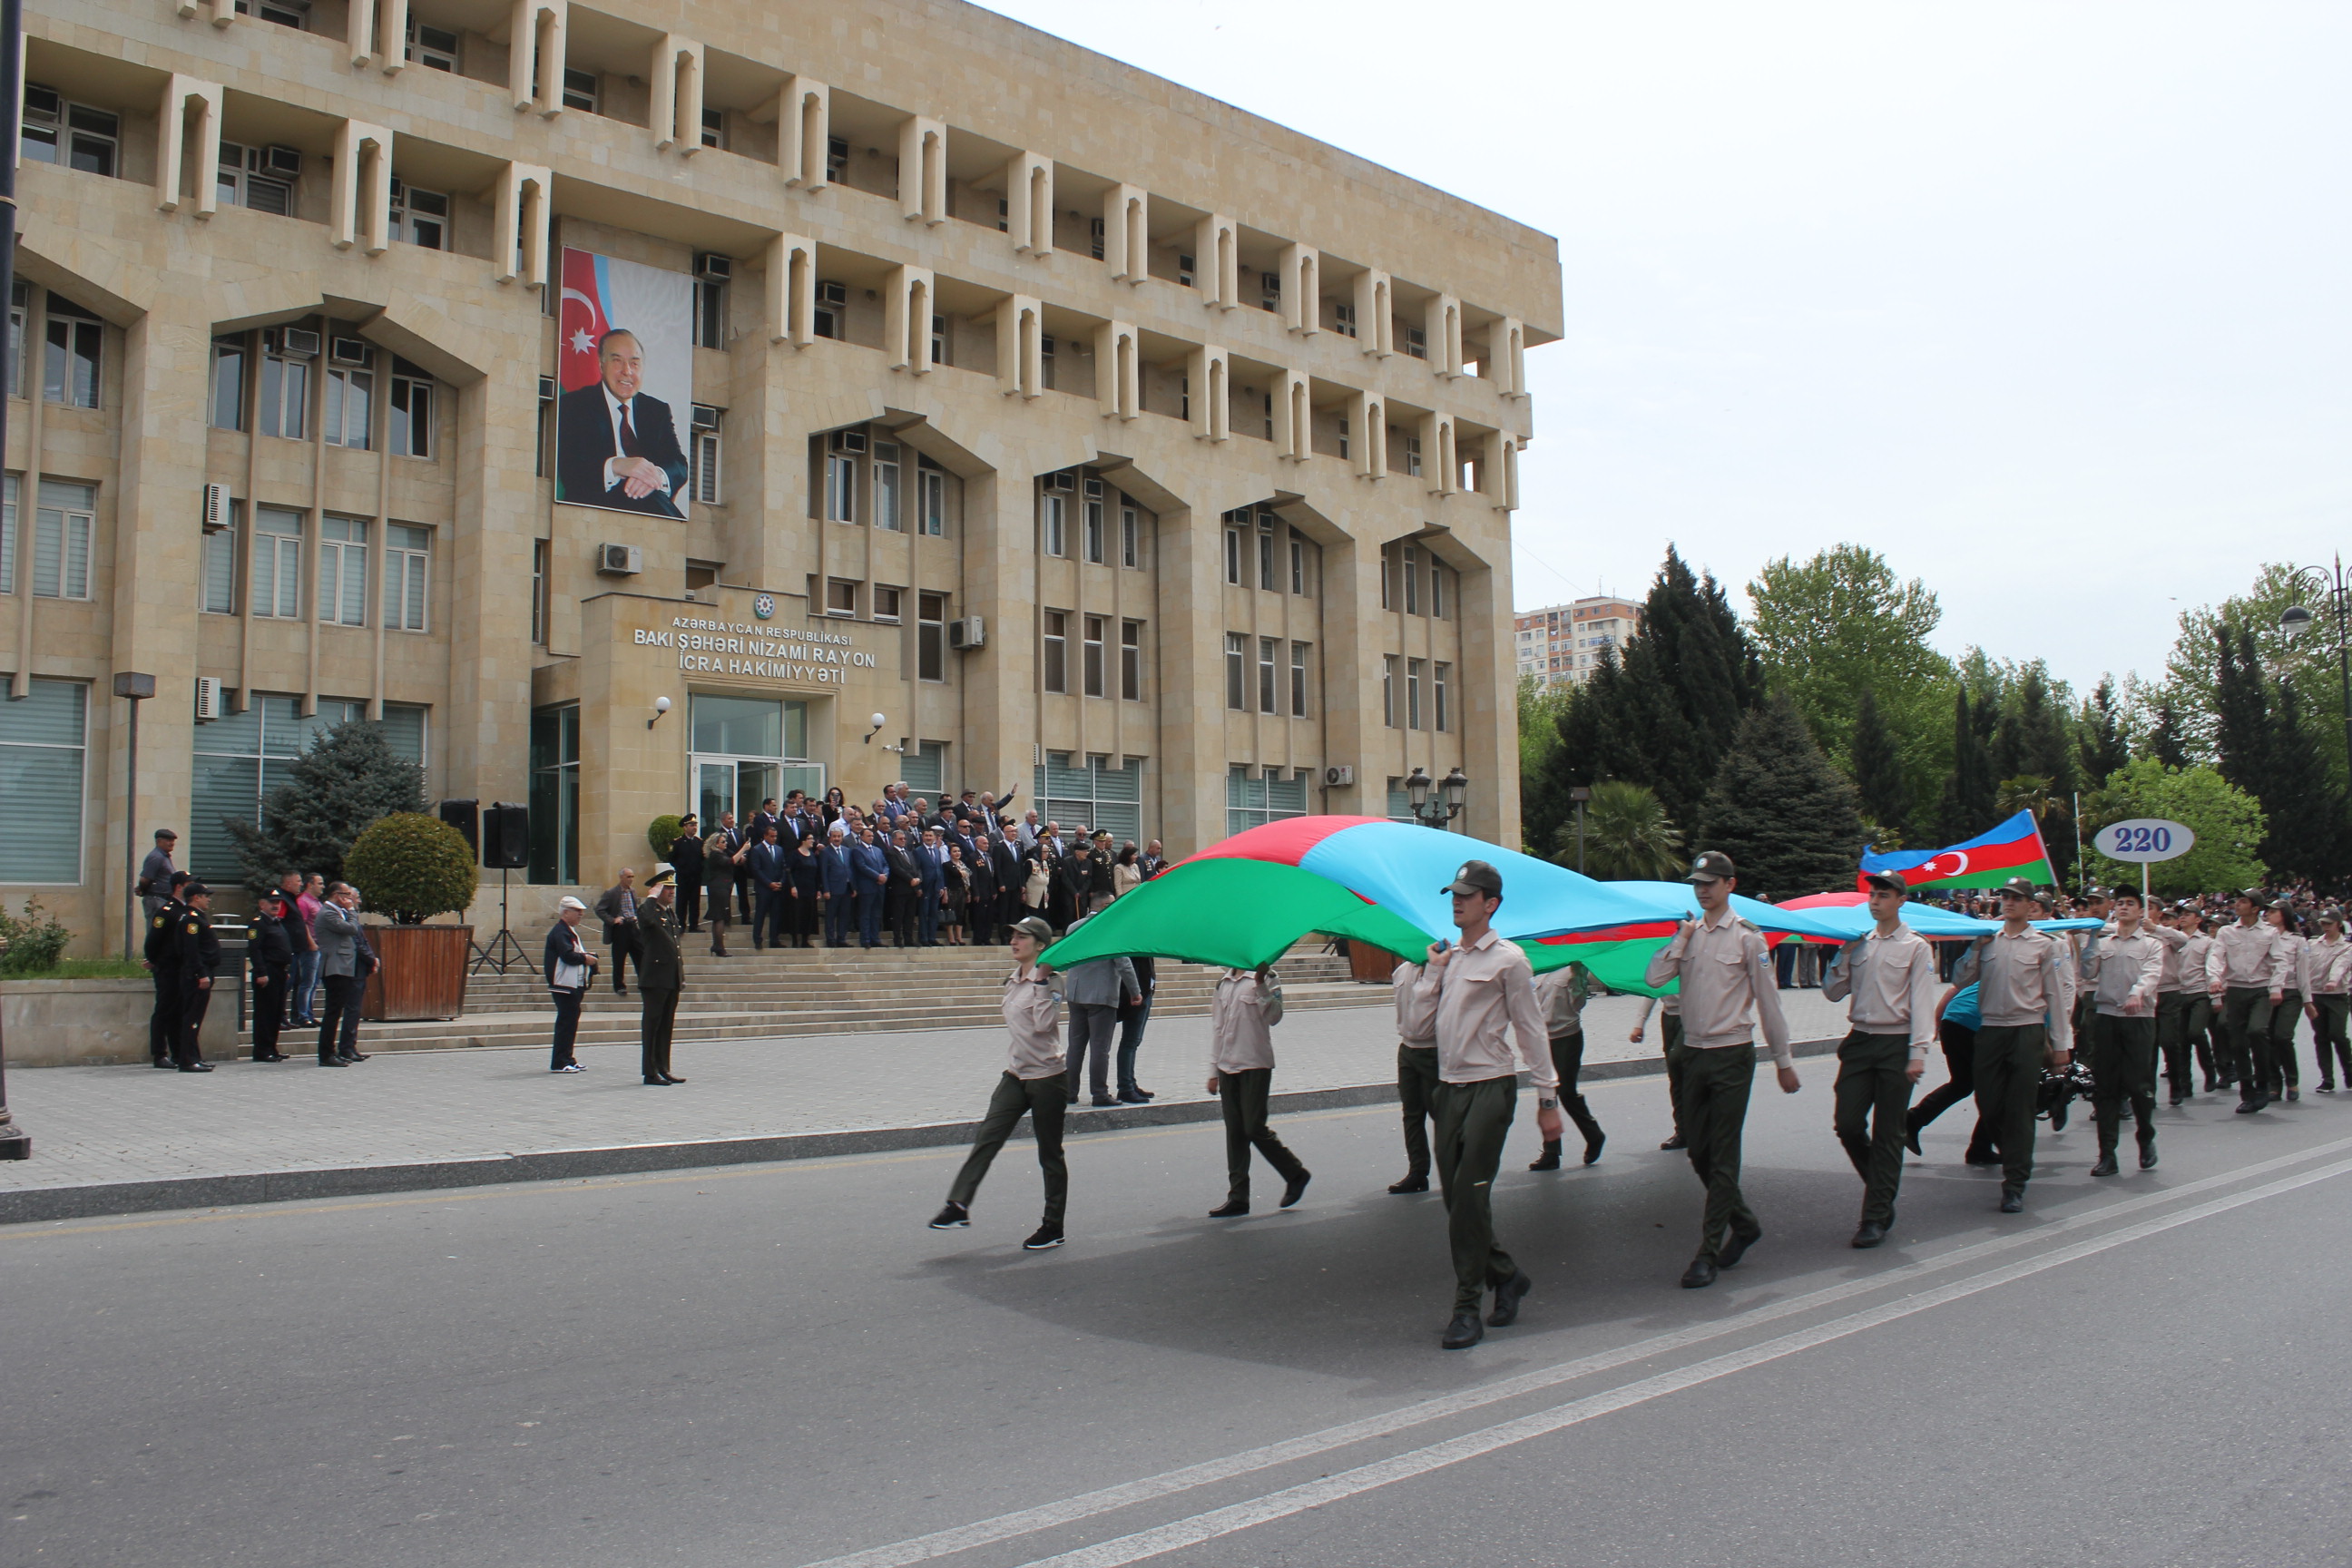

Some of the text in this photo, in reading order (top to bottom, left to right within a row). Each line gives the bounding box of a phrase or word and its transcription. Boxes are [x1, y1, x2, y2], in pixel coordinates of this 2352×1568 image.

[671, 617, 852, 646] AZƏRBAYCAN RESPUBLİKASI
[633, 629, 876, 668] BAKI ŞƏHƏRİ NİZAMİ RAYON
[679, 652, 846, 684] İCRA HAKİMİYYƏTİ
[2114, 827, 2171, 852] 220
